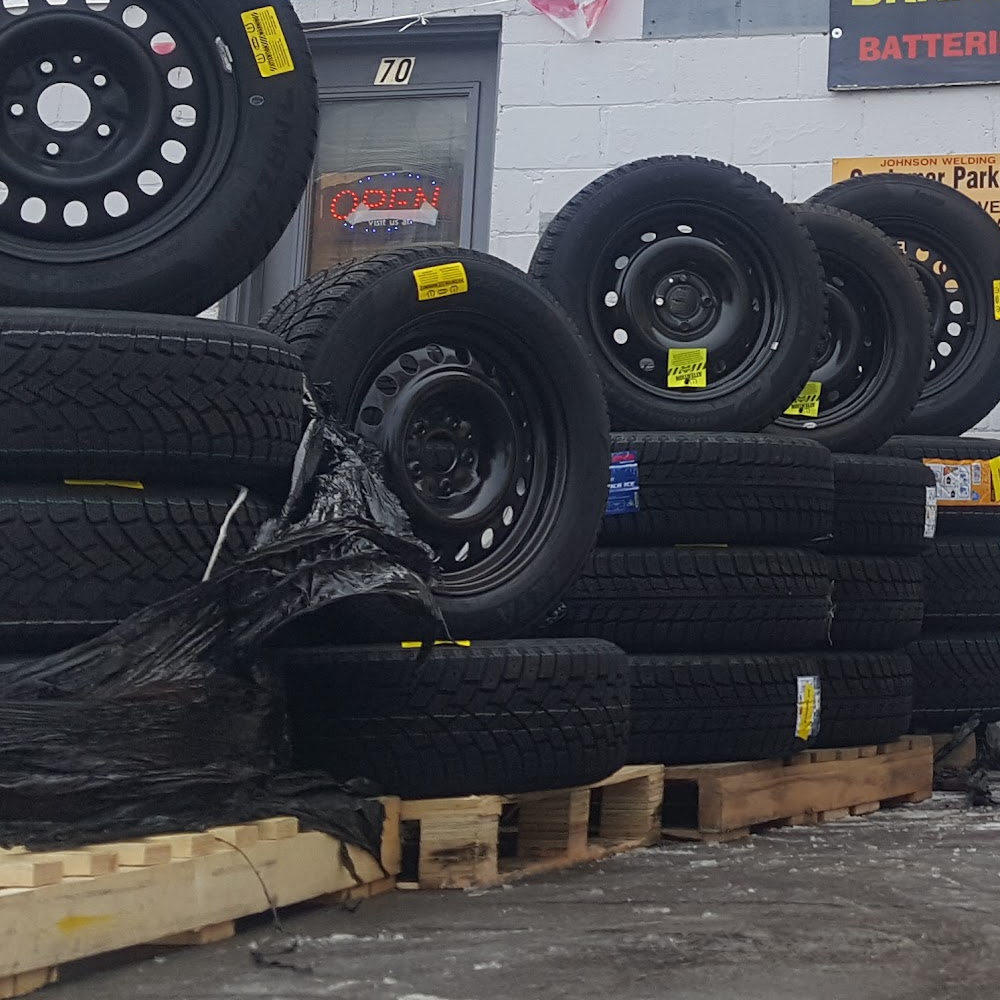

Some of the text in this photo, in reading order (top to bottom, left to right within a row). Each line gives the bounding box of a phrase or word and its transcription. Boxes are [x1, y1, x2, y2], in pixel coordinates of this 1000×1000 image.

[380, 58, 412, 83] 70
[880, 157, 938, 167] JOHNSON
[942, 156, 997, 166] WELDING
[330, 186, 440, 220] OPEN
